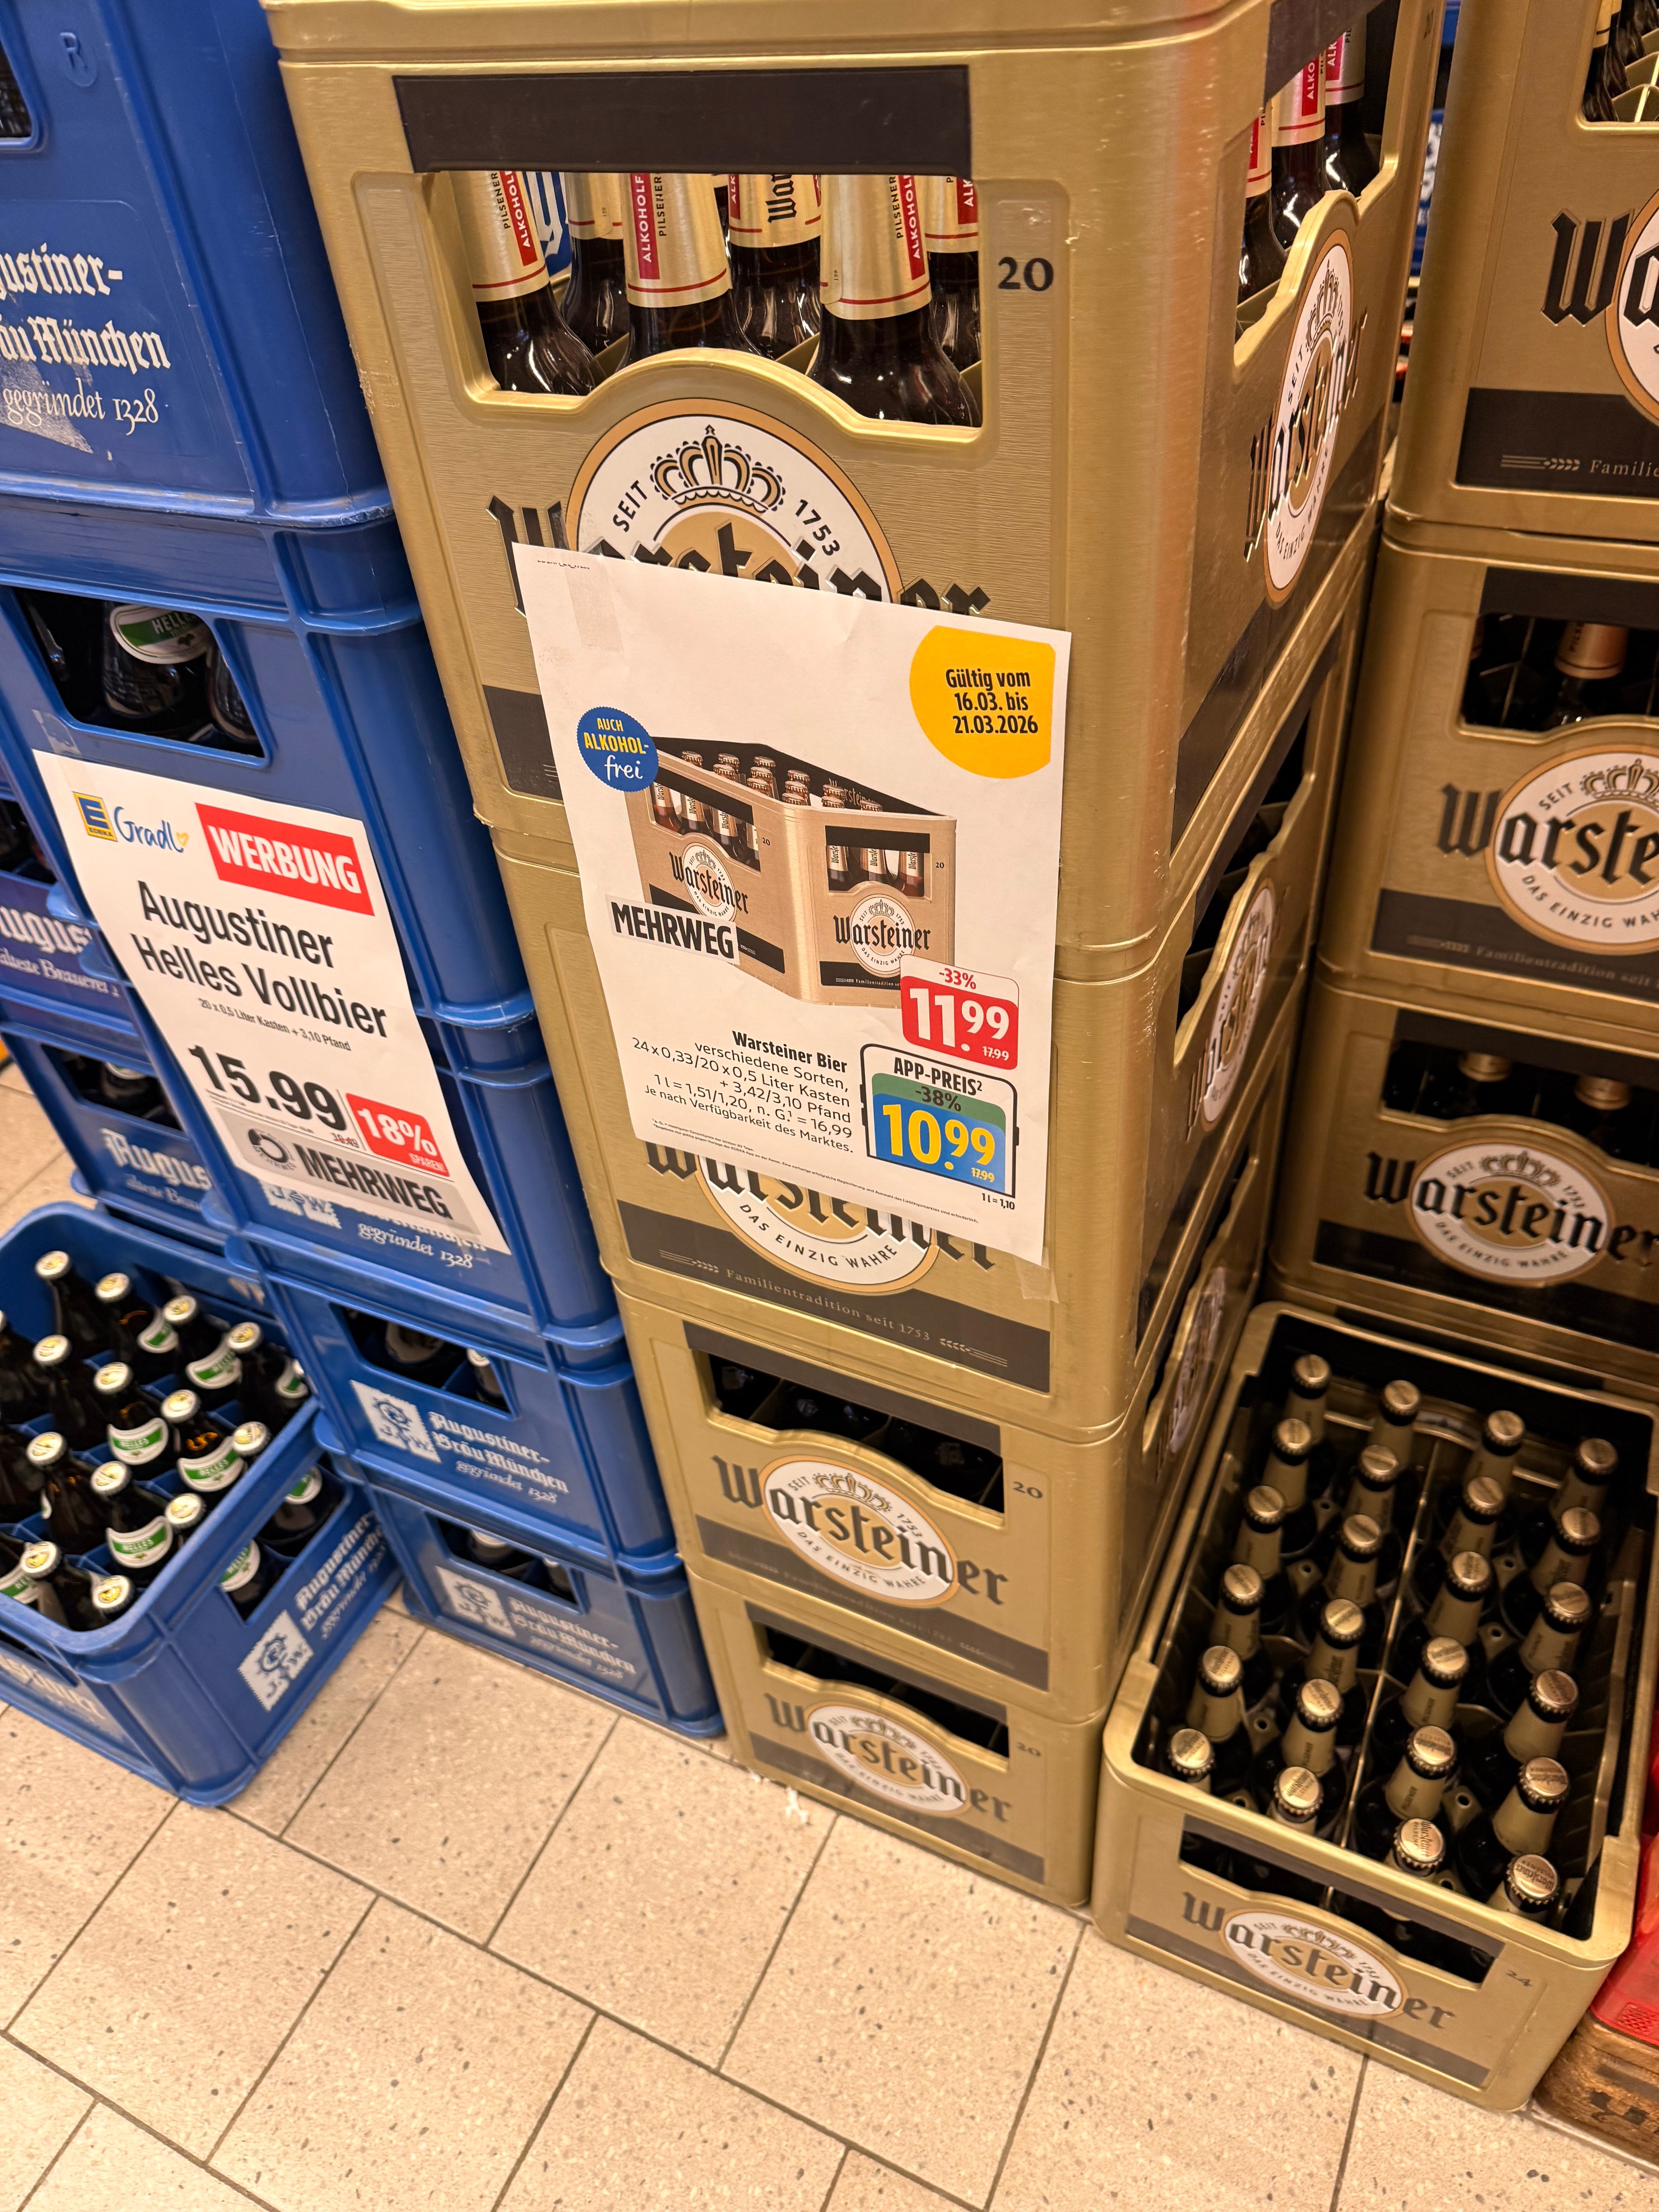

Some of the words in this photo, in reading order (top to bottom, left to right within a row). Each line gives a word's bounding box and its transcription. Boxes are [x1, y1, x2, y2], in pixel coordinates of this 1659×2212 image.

[491, 172, 511, 229] PILSENER
[654, 176, 667, 237] PILSENER
[889, 175, 903, 239] PILSENER
[0, 243, 122, 300] ustiner-
[998, 257, 1054, 292] 20
[27, 316, 171, 374] München
[3, 378, 105, 426] gegründet
[112, 388, 158, 435] 1328
[613, 480, 648, 532] SEIT
[795, 499, 841, 556] 1753
[945, 668, 993, 691] Gültig
[996, 671, 1031, 687] vom
[954, 692, 1003, 711] 16.03.
[1005, 692, 1029, 711] bis
[584, 732, 649, 754] ALKOHOL-
[596, 718, 623, 732] AUCH
[952, 715, 1038, 734] 21.03.2026
[604, 755, 643, 781] frei
[1539, 783, 1574, 811] SEIT
[114, 806, 184, 854] Gradl
[762, 837, 770, 846] 20
[206, 825, 362, 894] WERBUNG
[669, 851, 748, 914] Warsteiner
[137, 880, 334, 969] Augustiner
[1522, 875, 1547, 902] DAS
[1550, 902, 1613, 928] EINZIG
[611, 902, 735, 959] MEHRWEG
[833, 915, 931, 951] Warsteiner
[130, 933, 242, 997] Helles
[242, 963, 387, 1038] Vollbier
[939, 968, 977, 989] -33%
[234, 1008, 256, 1024] Liter
[257, 1015, 291, 1035] Kasten
[300, 1029, 322, 1044] 3,10
[322, 1034, 352, 1051] Pfand
[909, 988, 1010, 1052] 11.99
[695, 1042, 789, 1075] verschiedene
[794, 1066, 849, 1092] Sorten,
[732, 1030, 812, 1065] Warsteiner
[817, 1053, 847, 1073] Bier
[982, 1046, 1009, 1061] 17.99
[189, 1044, 347, 1131] 15.99
[733, 1082, 802, 1110] 3,42/3,10
[808, 1101, 850, 1123] Pfand
[762, 1073, 794, 1093] Liter
[800, 1084, 850, 1108] Kasten
[915, 1086, 962, 1112] -38%
[357, 1108, 437, 1157] 18%
[645, 1085, 657, 1097] Je
[659, 1089, 687, 1106] nach
[689, 1094, 771, 1131] Verfügbarkeit
[775, 1123, 796, 1137] des
[800, 1131, 854, 1154] Marktes.
[811, 1118, 852, 1139] 16,99
[883, 1104, 995, 1170] 10.99
[292, 1143, 454, 1220] MEHRWEG
[1447, 1160, 1473, 1179] SEIT
[1000, 1199, 1015, 1211] 1,10
[440, 1249, 473, 1268] 1328
[739, 1204, 770, 1231] DAS
[776, 1234, 839, 1266] EINZIG
[844, 1244, 898, 1269] WAHRE
[726, 1268, 861, 1318] Familientradition
[866, 1312, 895, 1329] seit
[899, 1323, 930, 1341] 1753
[428, 1411, 550, 1463] Augustiner-
[431, 1431, 485, 1462] Bräu
[485, 1450, 569, 1494] München
[788, 1476, 811, 1492] SEIT
[896, 1512, 923, 1538] 1753
[1013, 1480, 1043, 1499] 20
[711, 1454, 1009, 1605] Warsteiner
[797, 1531, 822, 1553] DAS
[826, 1554, 878, 1584] EINZIG
[885, 1575, 927, 1590] WAHRE
[764, 1692, 1013, 1822] Warsteiner
[1182, 1891, 1457, 2030] Warsteiner
